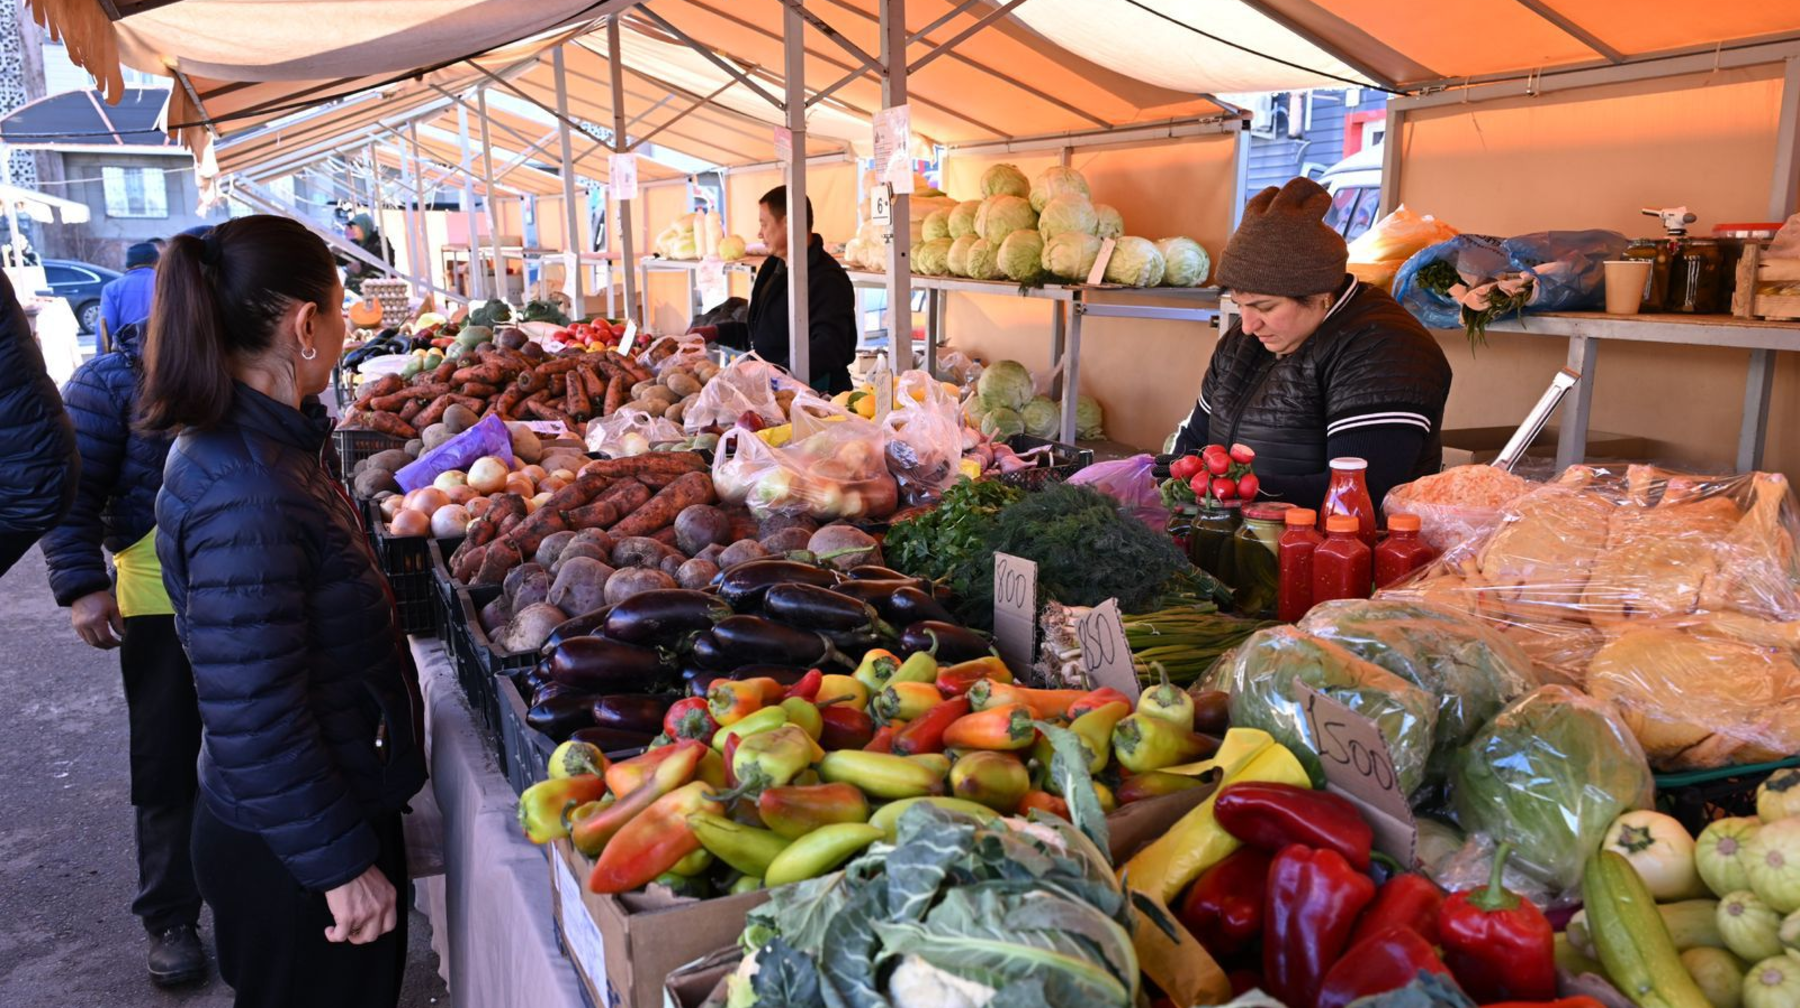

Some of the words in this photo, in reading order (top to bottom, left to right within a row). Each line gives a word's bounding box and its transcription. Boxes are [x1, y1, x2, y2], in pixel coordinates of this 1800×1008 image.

[997, 559, 1027, 609] 800
[1078, 612, 1115, 672] 850
[1307, 694, 1394, 790] 1500
